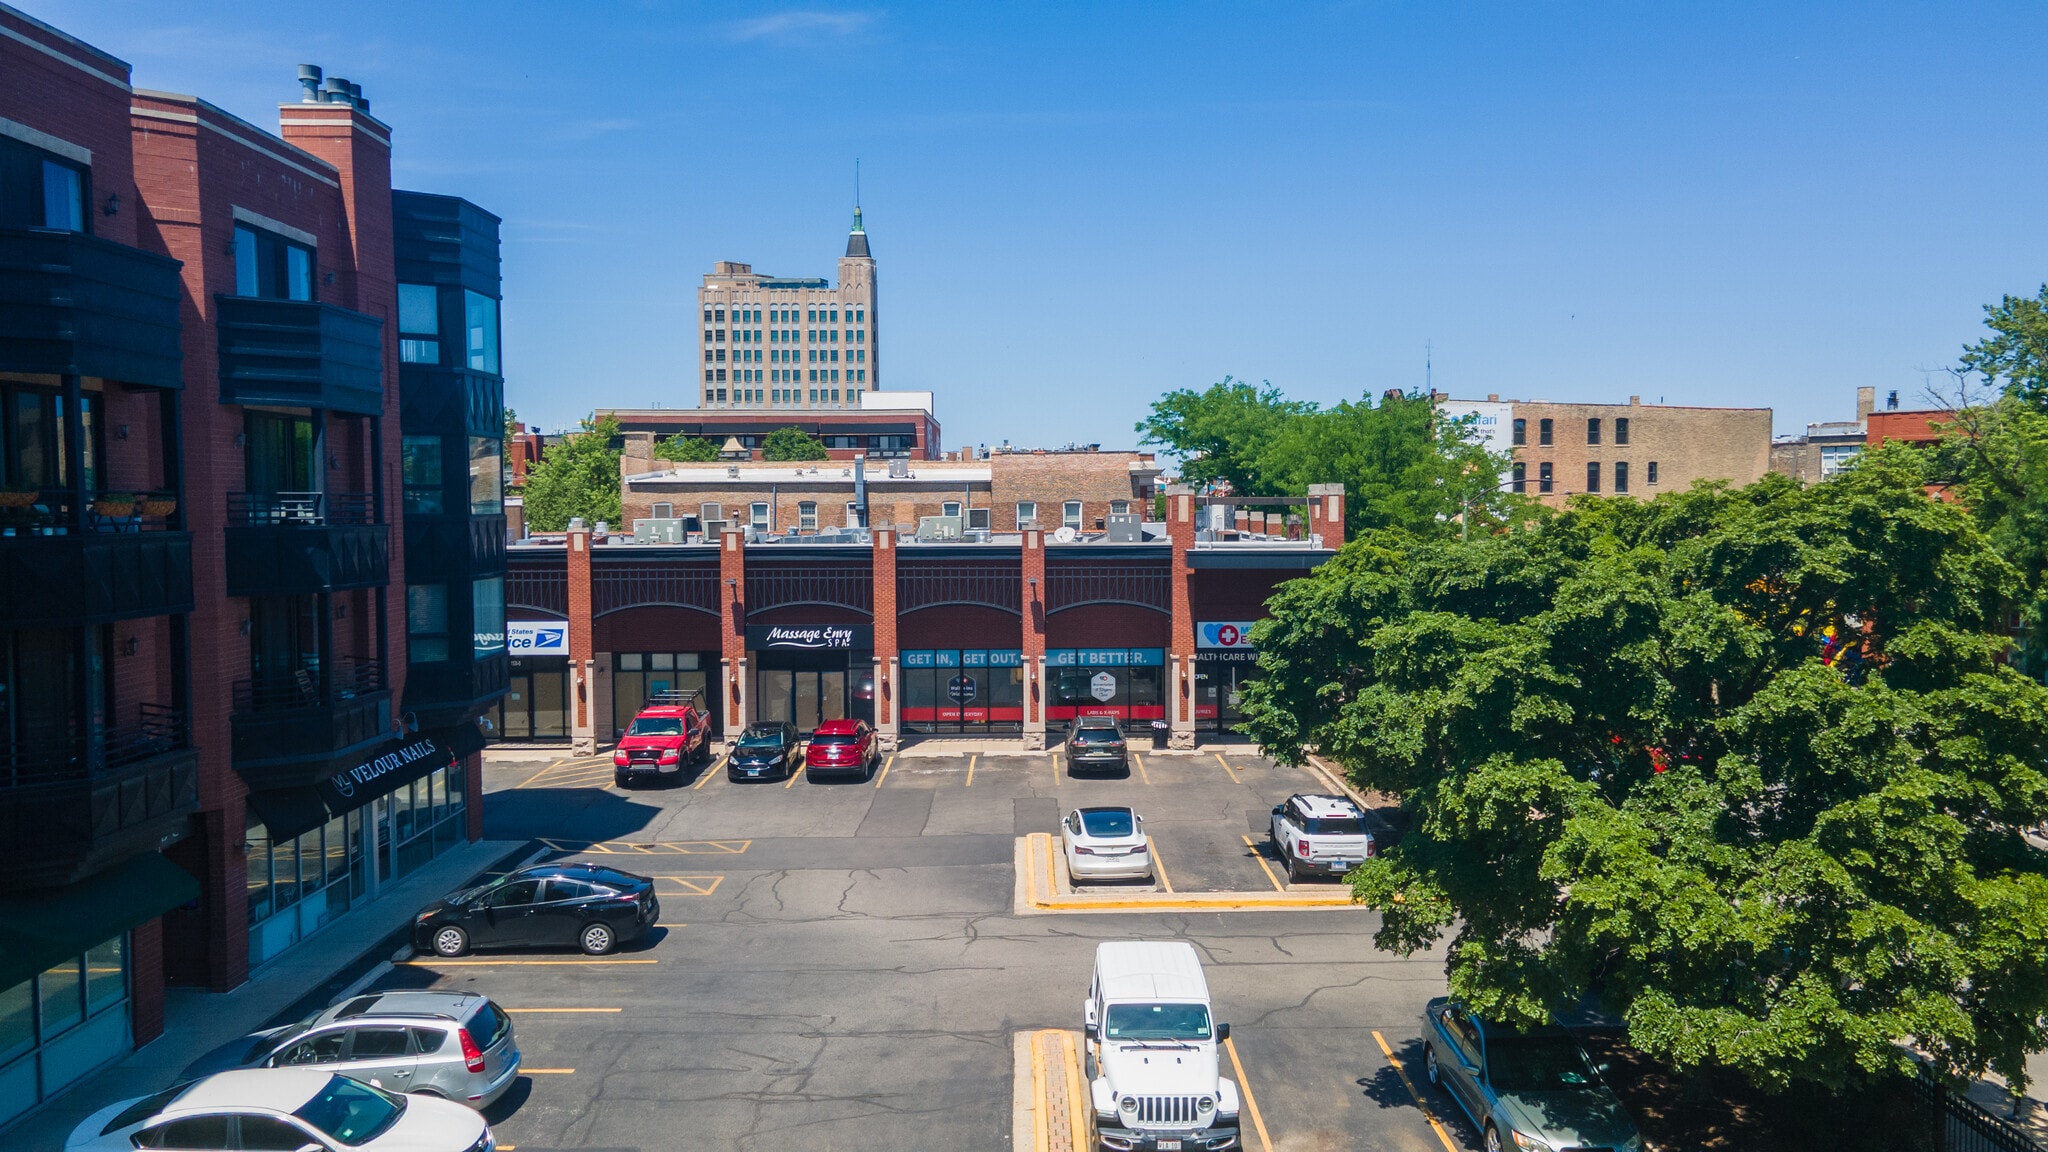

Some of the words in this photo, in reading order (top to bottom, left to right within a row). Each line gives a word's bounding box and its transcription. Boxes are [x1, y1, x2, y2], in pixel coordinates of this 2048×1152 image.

[766, 626, 821, 643] Massage
[823, 626, 852, 642] Envy
[907, 653, 932, 664] GET
[936, 654, 953, 666] IN,
[963, 653, 986, 664] GET
[990, 653, 1019, 665] OUT,
[1057, 652, 1086, 664] GET
[1089, 652, 1148, 664] BETTER.
[350, 752, 403, 784] VELOUR
[399, 738, 436, 763] NAILS
